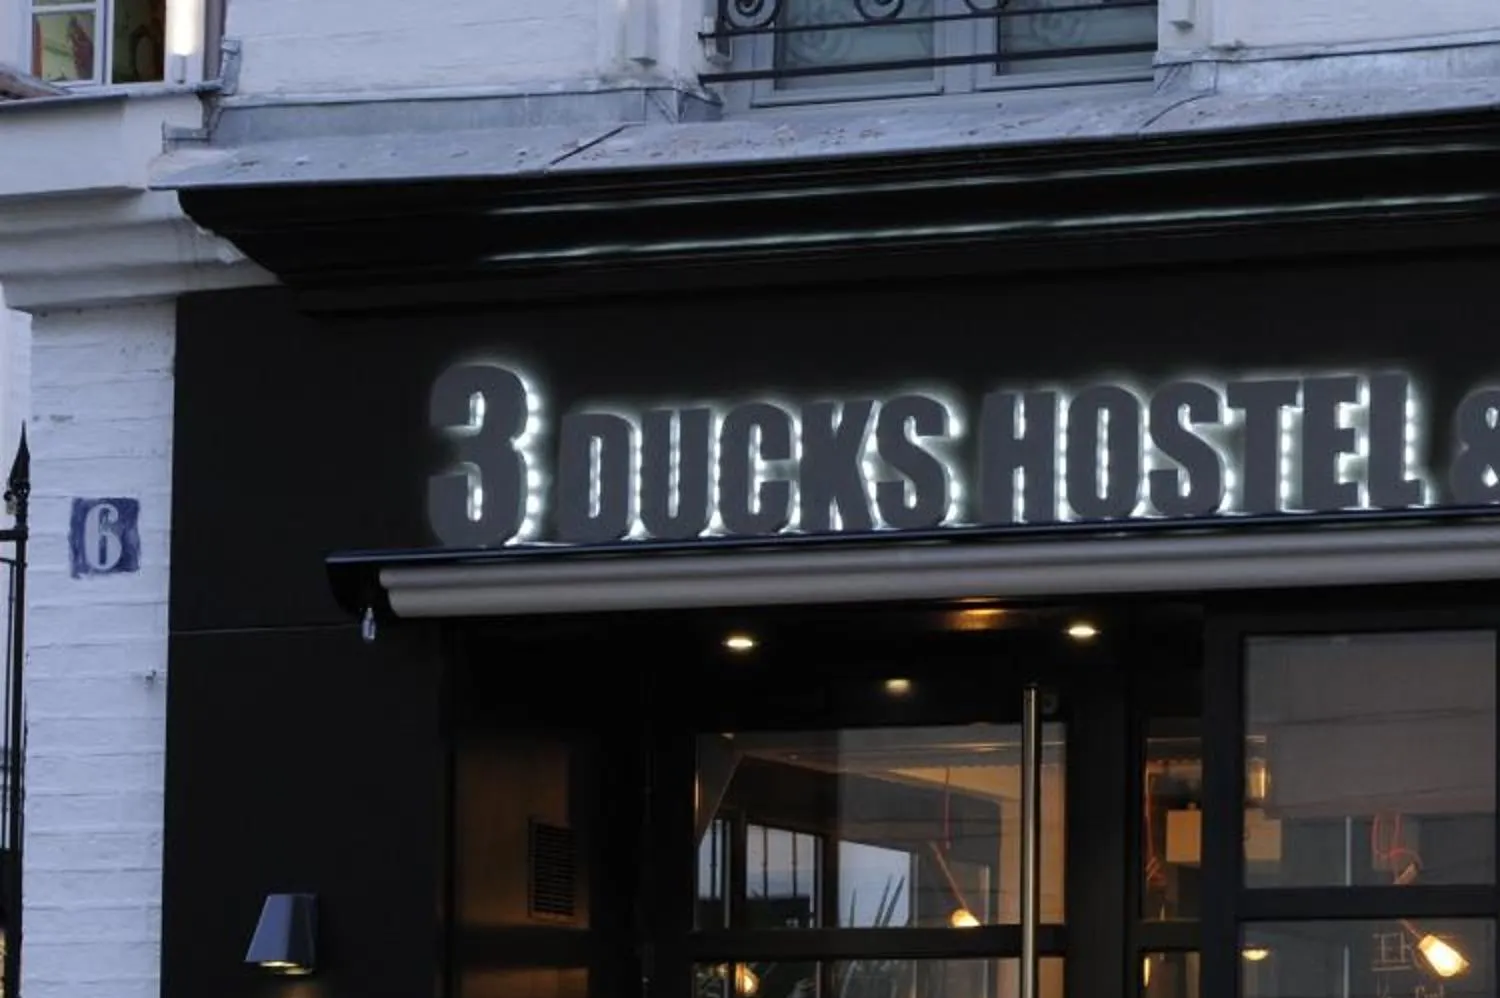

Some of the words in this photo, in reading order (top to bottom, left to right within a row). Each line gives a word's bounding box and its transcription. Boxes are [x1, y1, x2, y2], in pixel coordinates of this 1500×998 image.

[427, 360, 535, 547] 3
[560, 392, 960, 542] DUCKS
[980, 372, 1424, 524] HOSTEL
[84, 502, 123, 571] 6
